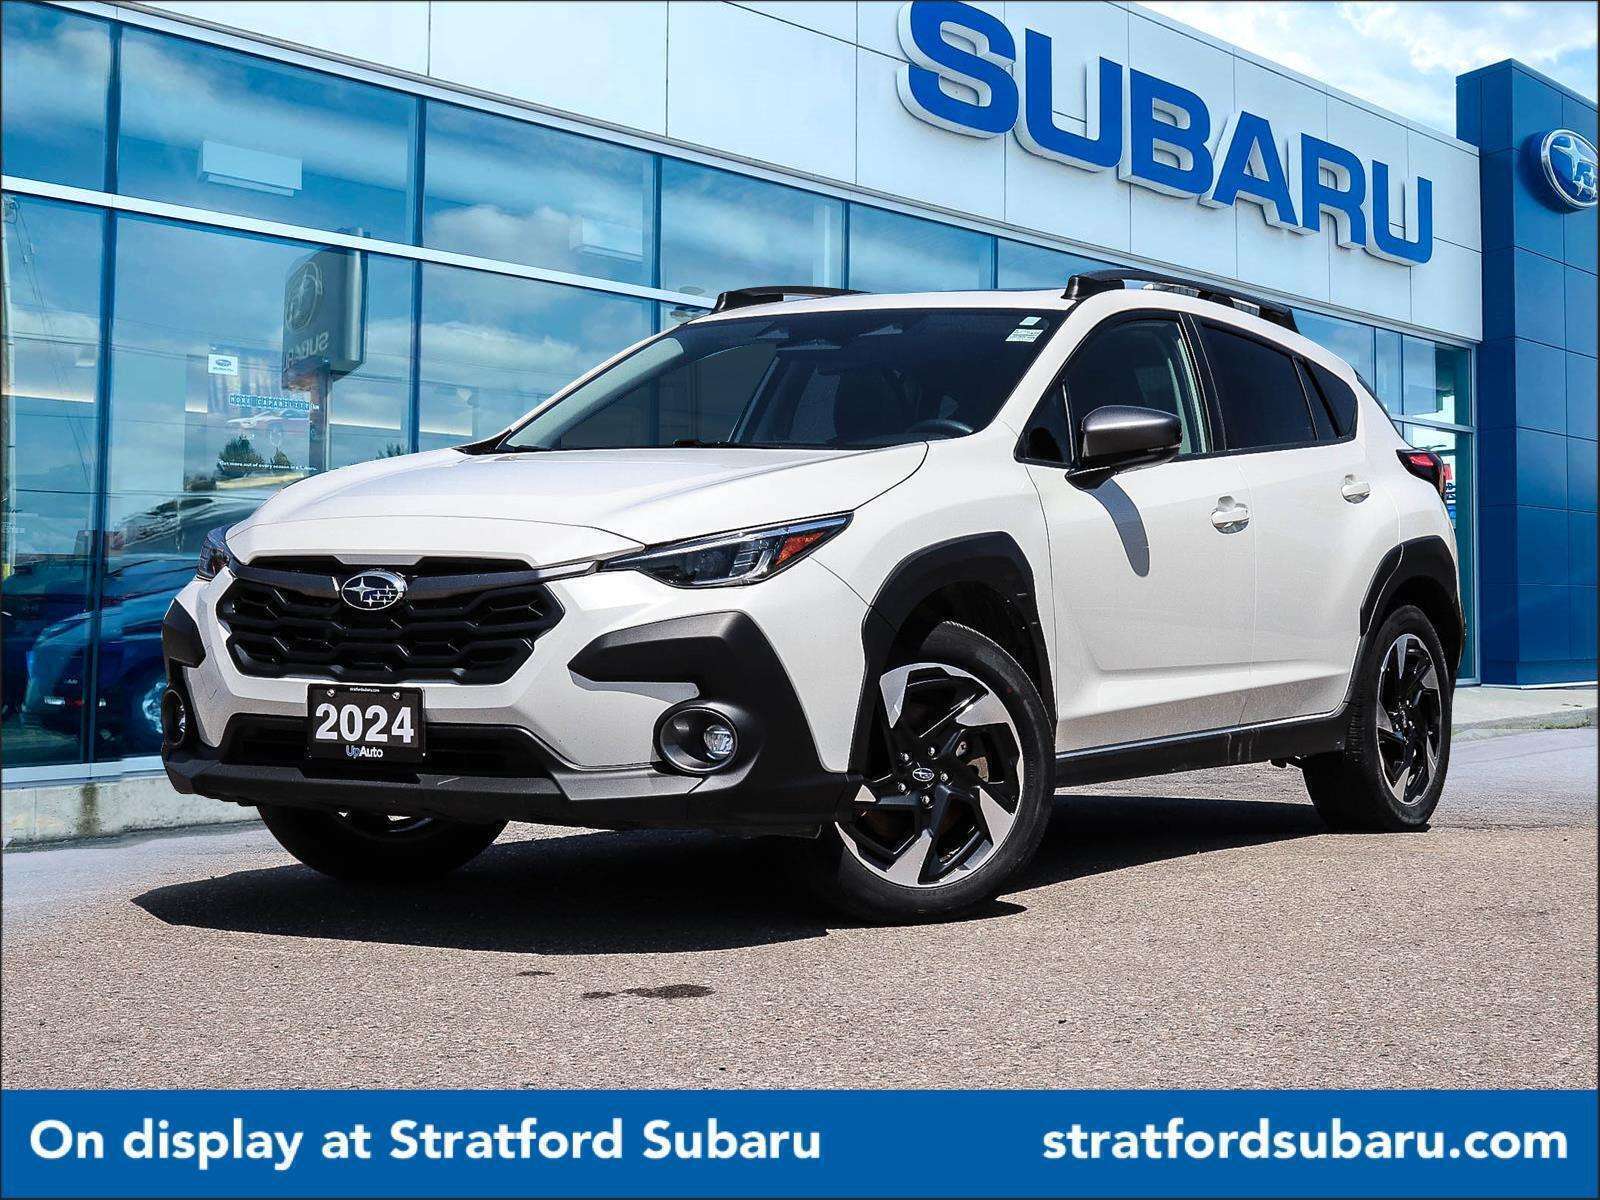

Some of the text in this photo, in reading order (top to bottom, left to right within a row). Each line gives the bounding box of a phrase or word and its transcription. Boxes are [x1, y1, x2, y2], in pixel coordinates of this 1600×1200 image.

[902, 0, 1434, 266] SUBARU
[315, 702, 415, 744] 2024
[345, 744, 384, 759] UpAuto
